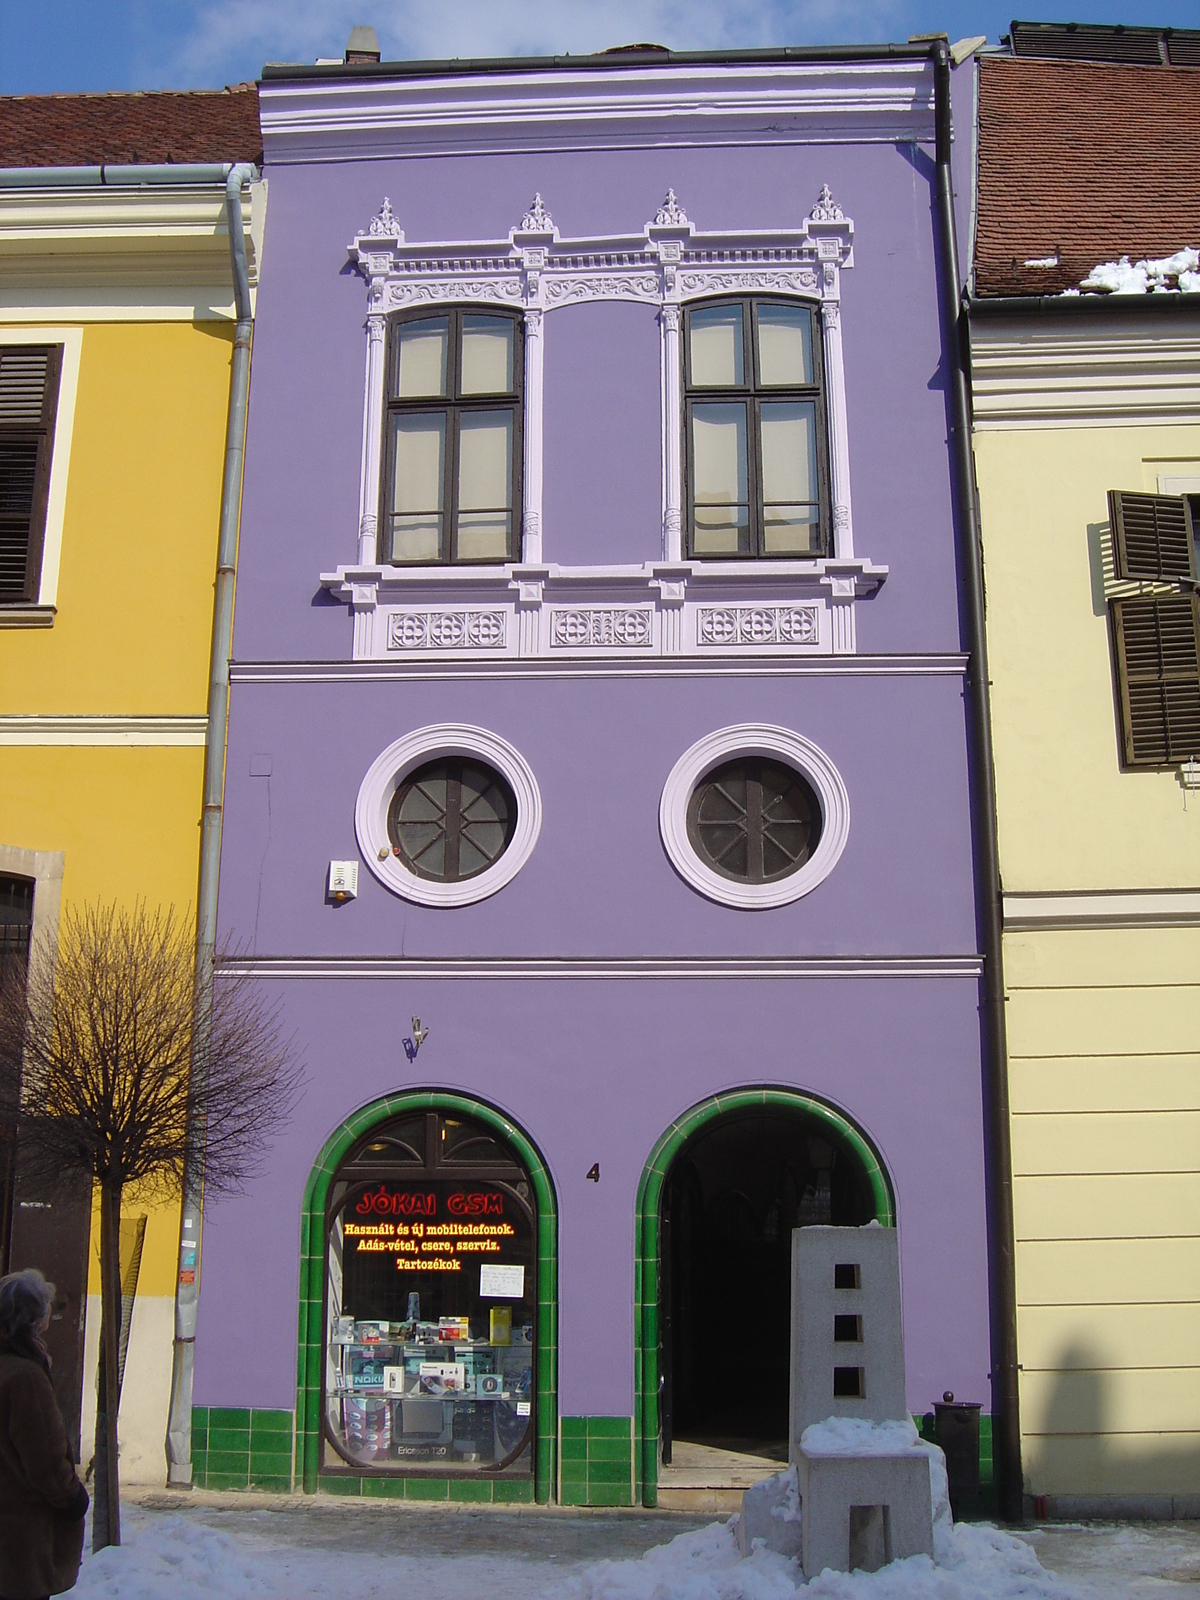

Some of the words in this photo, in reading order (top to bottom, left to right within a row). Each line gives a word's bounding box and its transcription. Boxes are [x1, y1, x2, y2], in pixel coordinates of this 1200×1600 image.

[586, 1162, 600, 1183] 4
[356, 1185, 436, 1215] JÓKAI
[447, 1193, 503, 1215] GSM
[344, 1222, 395, 1235] Használt
[397, 1222, 410, 1235] és
[411, 1222, 424, 1237] új
[426, 1223, 515, 1235] mobiltelefonok.
[357, 1238, 419, 1254] Adás-vétel,
[421, 1241, 454, 1254] csere,
[456, 1239, 500, 1251] szerviz.
[397, 1258, 461, 1270] Tartozékok
